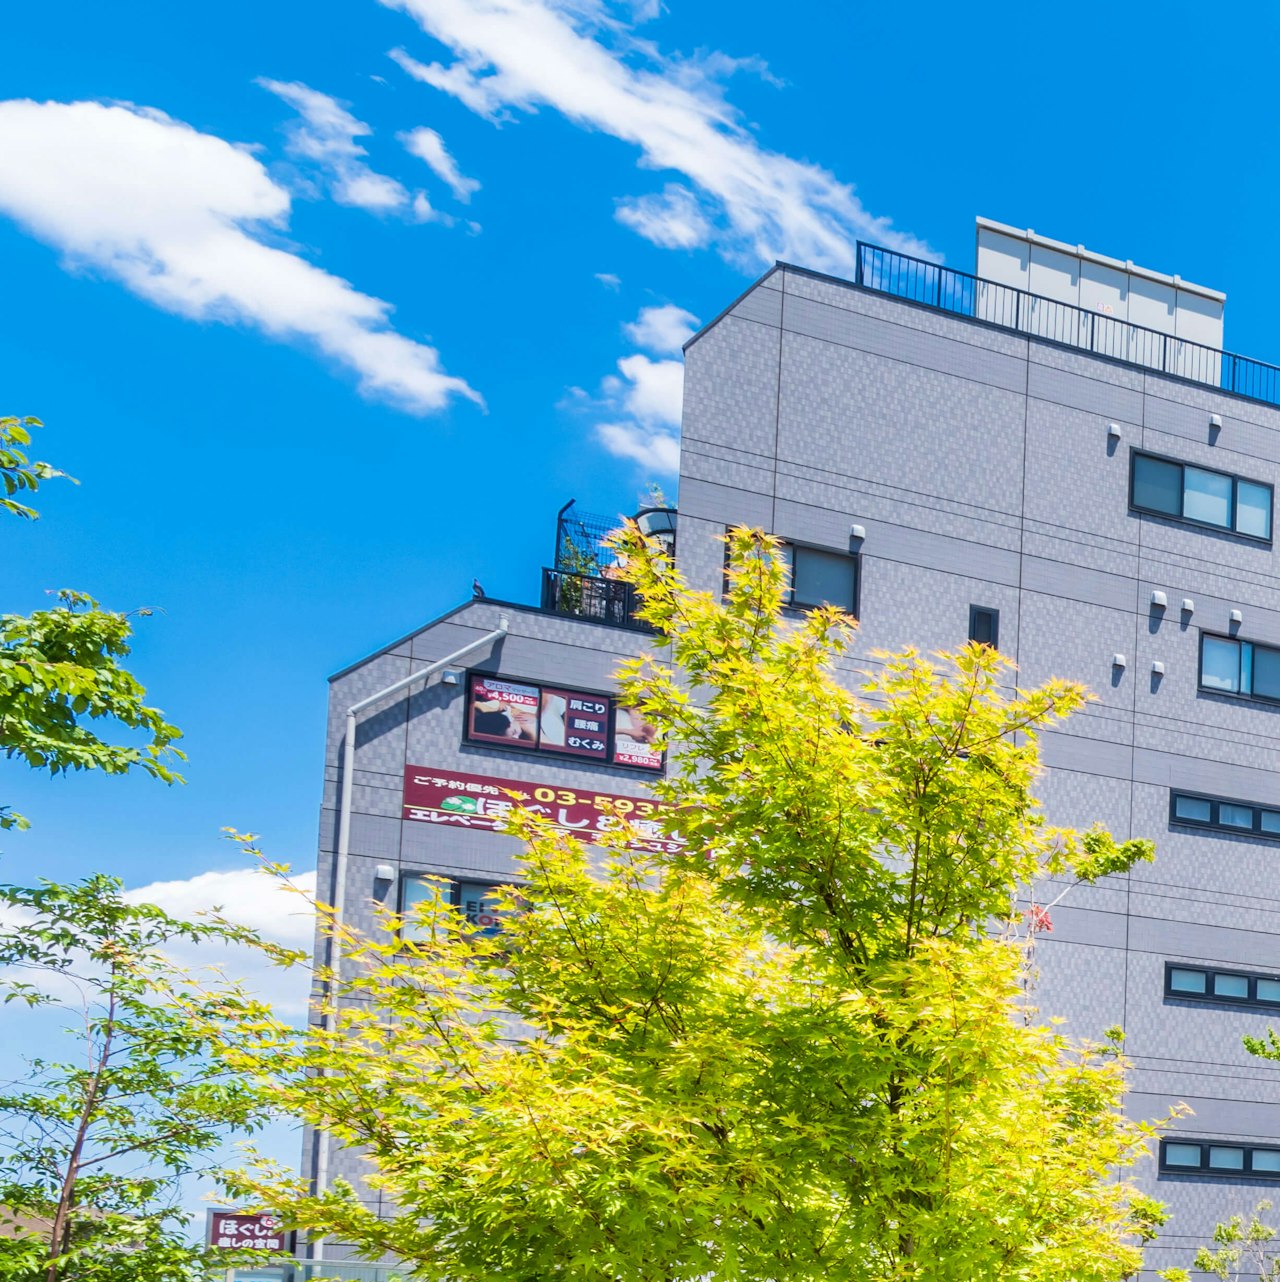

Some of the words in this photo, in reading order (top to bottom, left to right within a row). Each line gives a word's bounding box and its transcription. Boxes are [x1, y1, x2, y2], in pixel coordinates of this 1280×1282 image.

[569, 699, 606, 715] 肩こり
[574, 718, 600, 732] 腰痛
[568, 736, 605, 751] むくみ
[413, 775, 500, 795] ご予約優先
